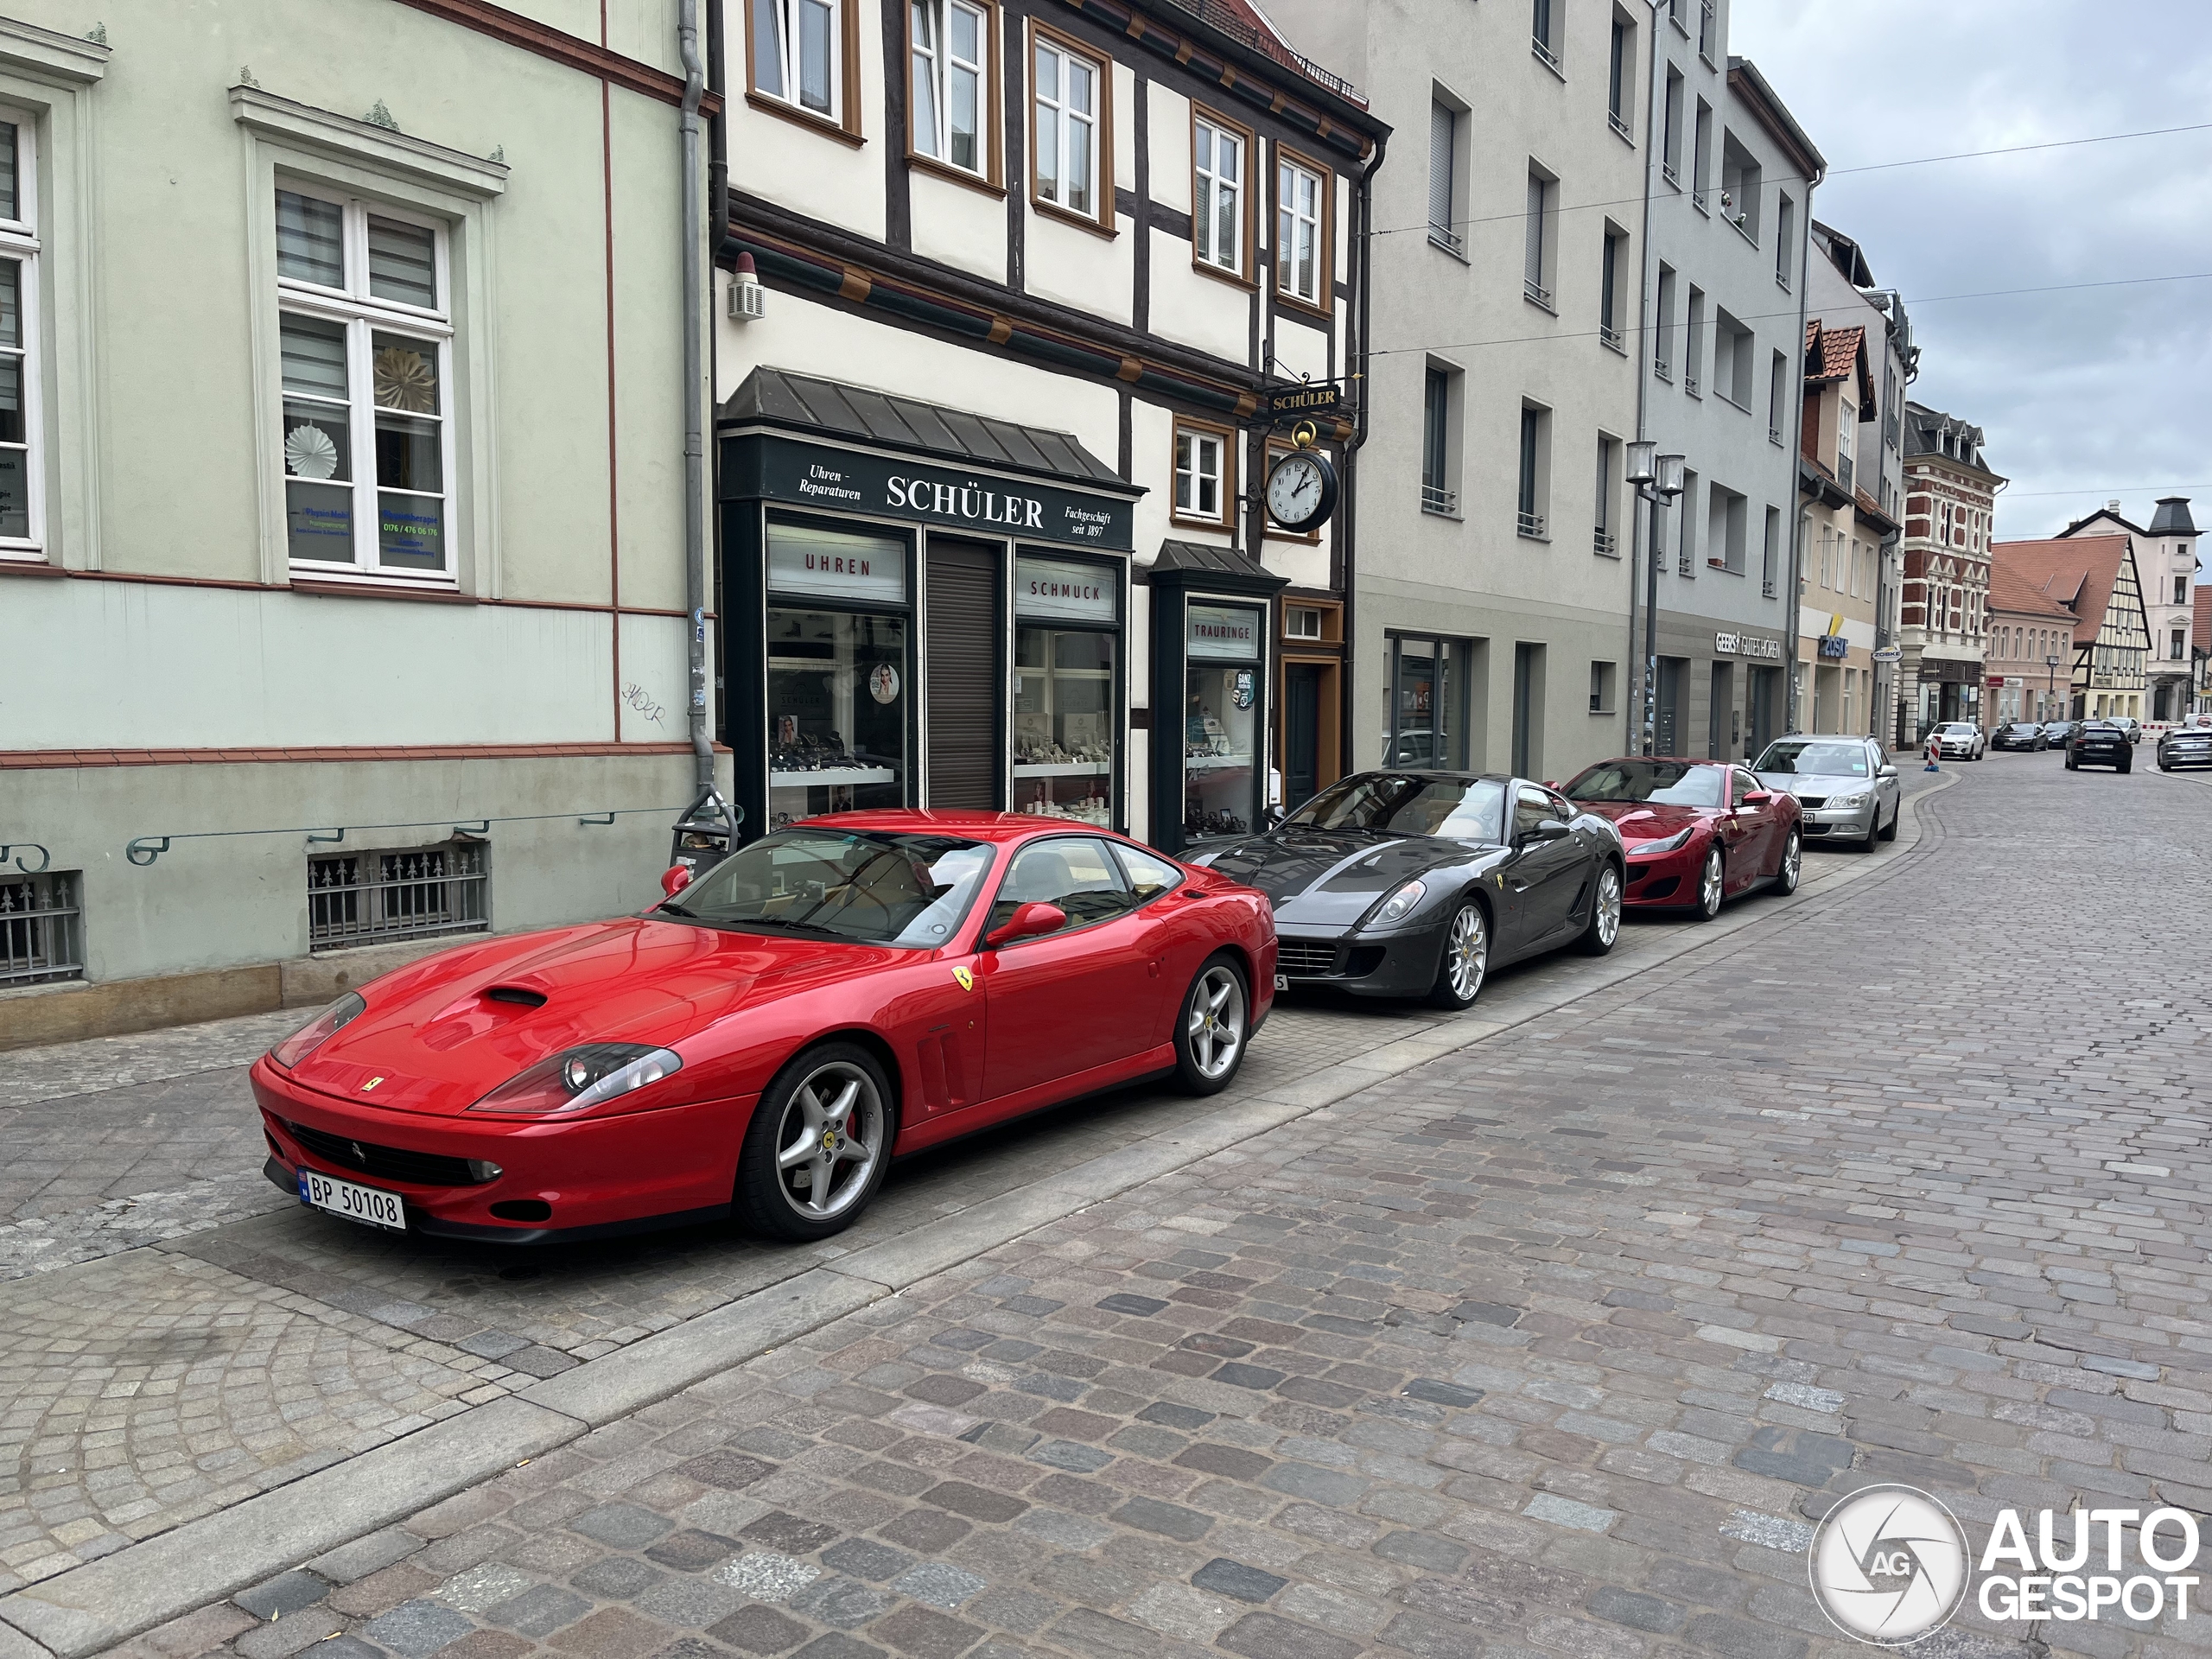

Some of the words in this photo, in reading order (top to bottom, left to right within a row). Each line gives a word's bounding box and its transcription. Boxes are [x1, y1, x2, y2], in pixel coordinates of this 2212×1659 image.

[1273, 391, 1335, 410] SCHÜLER
[810, 464, 842, 482] Uhren
[798, 479, 861, 501] Reparaturen
[887, 475, 1044, 529] SCHÜLER
[1065, 505, 1111, 525] Fachgeschäft
[384, 523, 398, 532] 0176
[404, 525, 416, 534] 476
[428, 528, 438, 537] 176
[1071, 524, 1084, 535] seit
[1086, 524, 1103, 537] 1897
[805, 553, 870, 576] UHREN
[1031, 581, 1100, 601] SCHMUCK
[1195, 625, 1249, 639] TRAURINGE
[1716, 632, 1736, 653] GEERS
[1741, 636, 1760, 657] GUTES
[781, 695, 820, 704] SCHÜLER
[311, 1176, 333, 1205] BP
[342, 1185, 397, 1223] 50108
